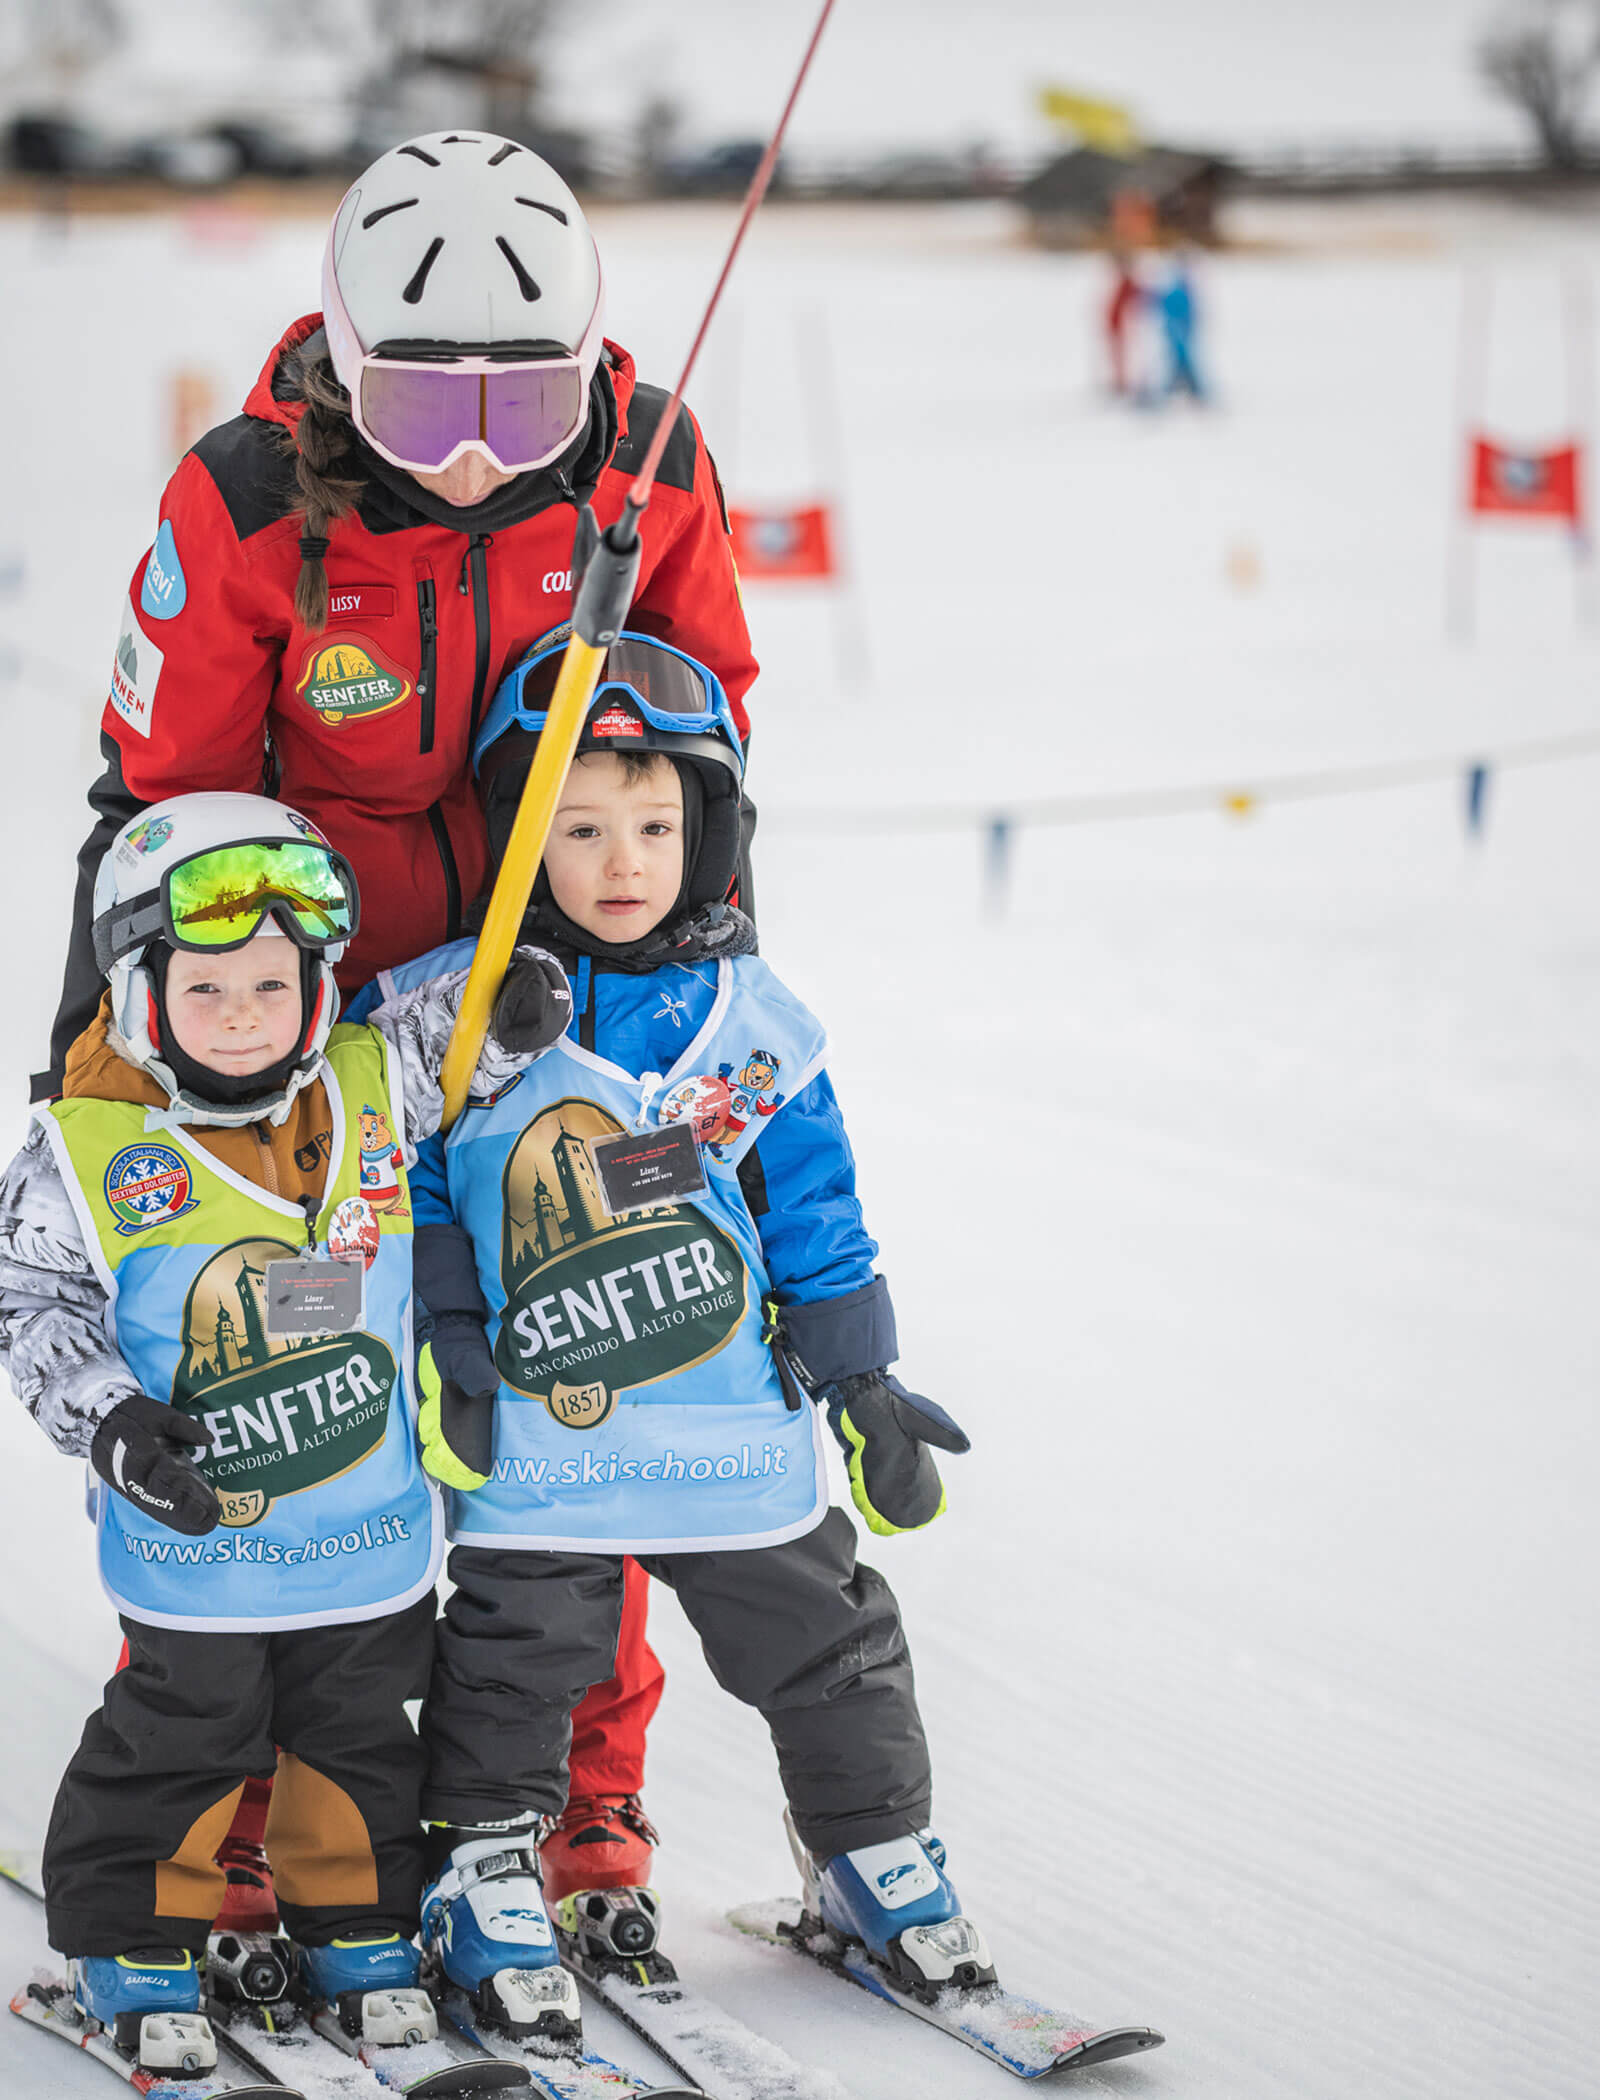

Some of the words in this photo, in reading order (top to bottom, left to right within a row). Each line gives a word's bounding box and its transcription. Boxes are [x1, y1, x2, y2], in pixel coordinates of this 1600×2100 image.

[331, 596, 361, 612] LISSY
[111, 1185, 143, 1201] SEXTNER
[144, 1171, 186, 1190] DOLOMITEN
[524, 1361, 551, 1380] SAN
[552, 1337, 619, 1371] CANDIDO
[641, 1310, 685, 1338] ALTO
[691, 1292, 736, 1320] ADIGE
[558, 1388, 601, 1418] 1857
[218, 1450, 282, 1476] CANDIDO
[303, 1420, 341, 1451] ALTO
[346, 1399, 387, 1432] ADIGE
[487, 1444, 787, 1485] ww.skischool.it
[128, 1480, 175, 1511] reusch
[119, 1514, 411, 1565] www.skischool.it
